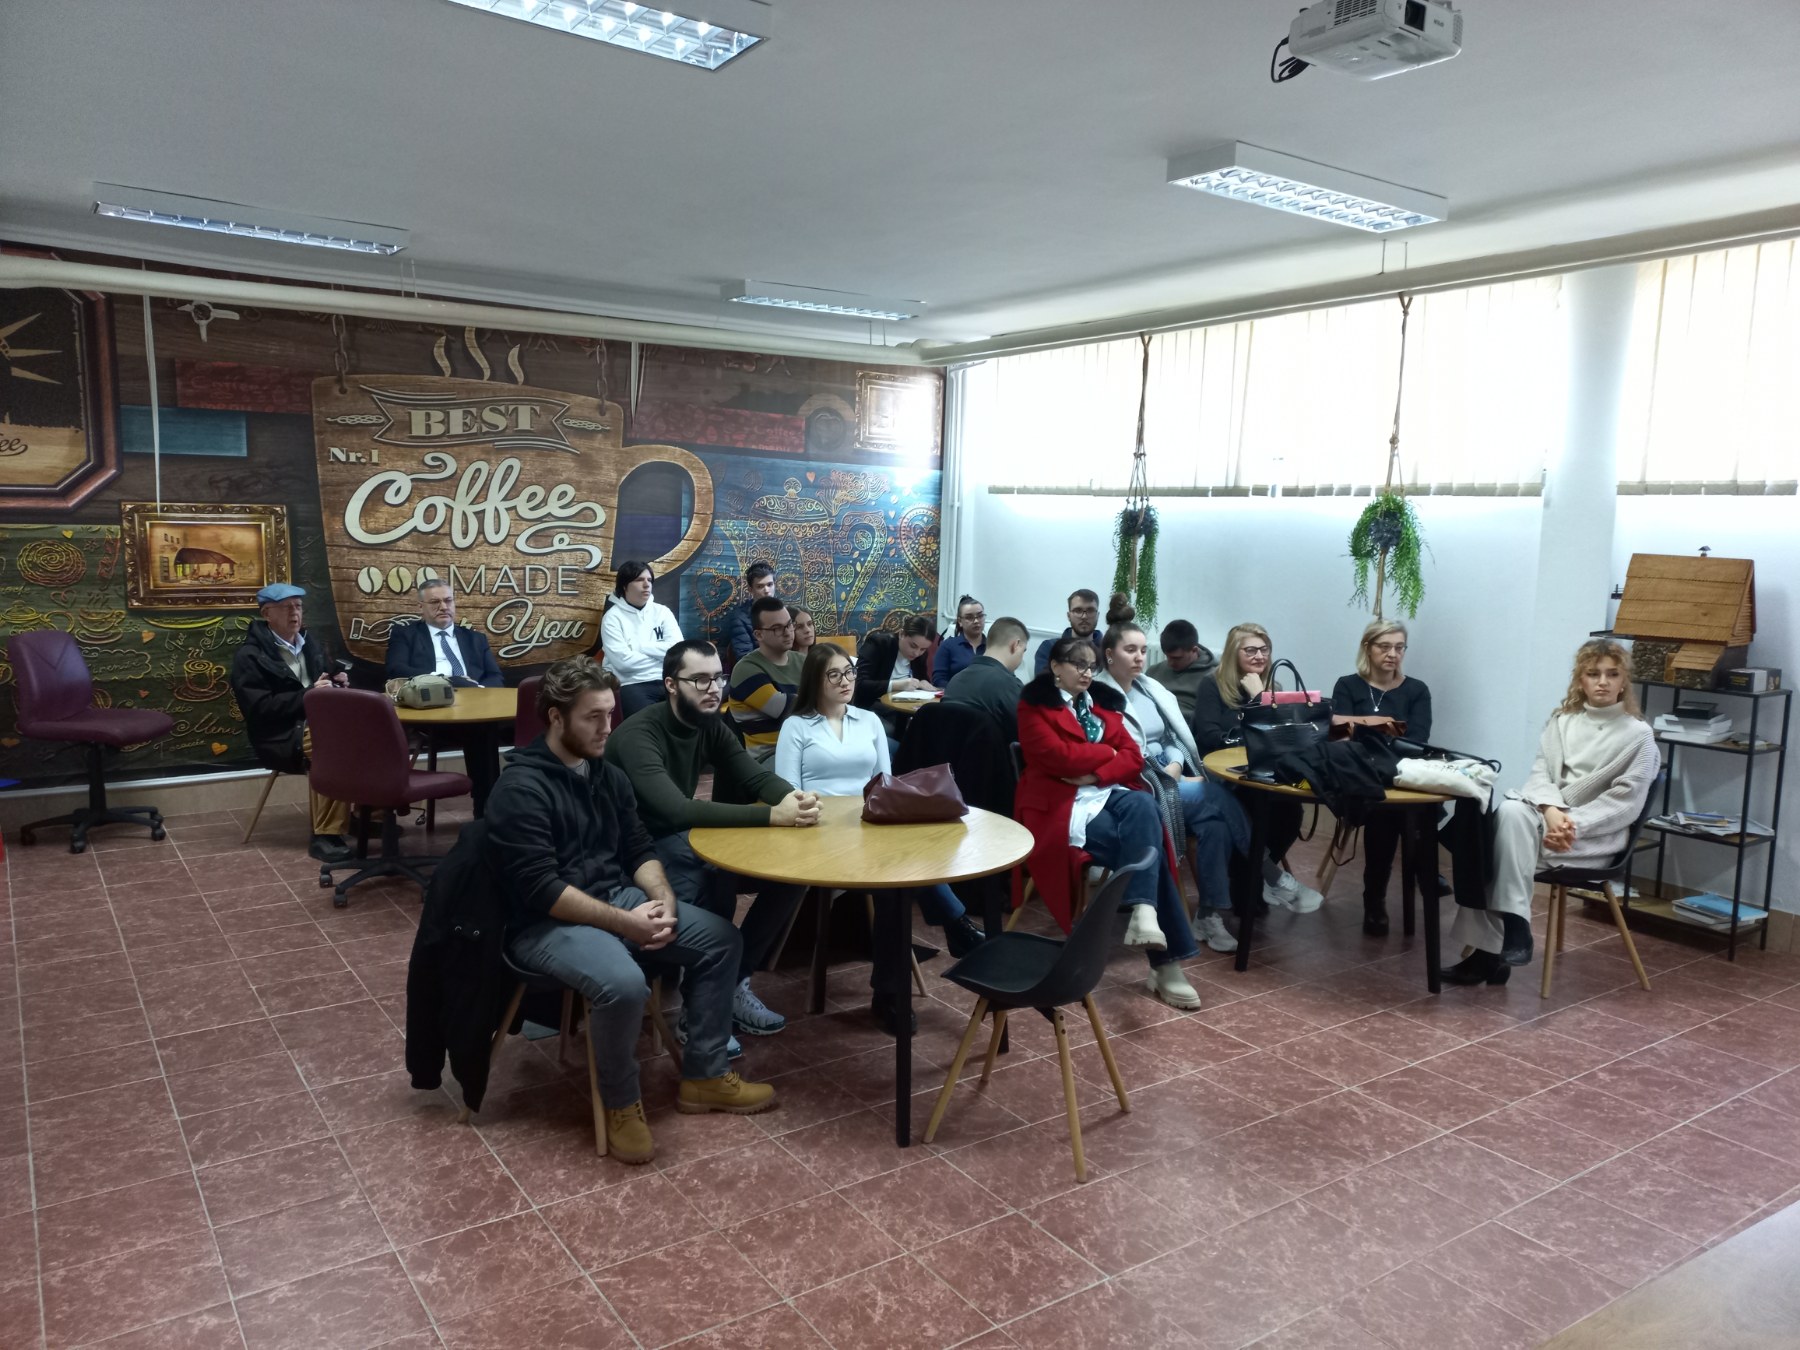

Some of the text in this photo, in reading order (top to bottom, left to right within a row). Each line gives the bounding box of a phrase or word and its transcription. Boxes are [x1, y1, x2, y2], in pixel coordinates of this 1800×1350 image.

[408, 403, 541, 438] BEST
[327, 446, 380, 465] Nr.1
[344, 451, 606, 550] Coffee
[448, 563, 581, 595] MADE
[485, 598, 586, 659] You
[653, 626, 665, 640] W
